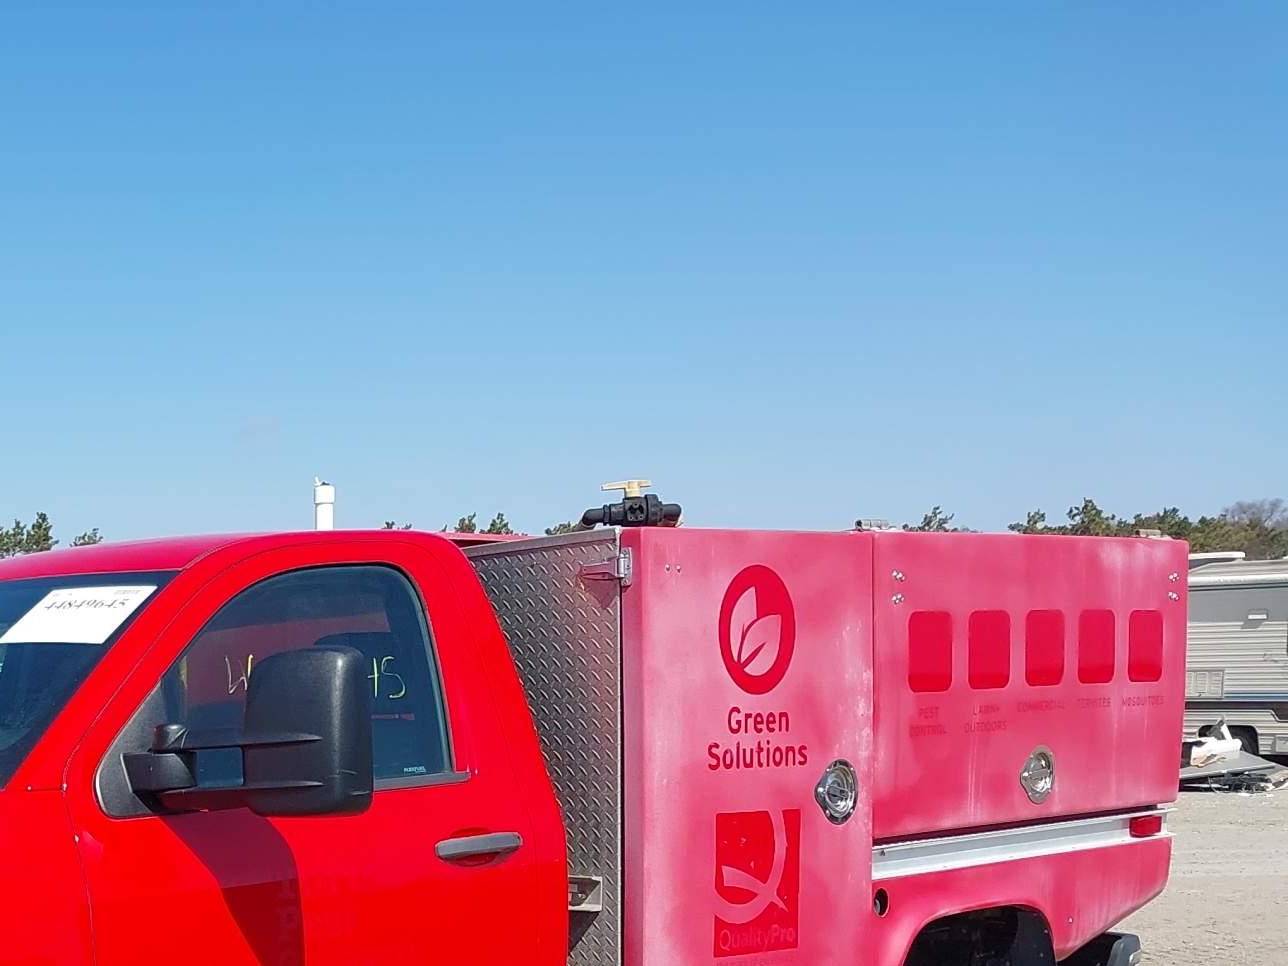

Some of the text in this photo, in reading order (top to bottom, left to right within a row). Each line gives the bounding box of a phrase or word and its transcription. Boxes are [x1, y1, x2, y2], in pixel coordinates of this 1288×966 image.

[728, 706, 789, 734] Green
[708, 739, 808, 770] Solutions
[719, 924, 795, 953] QualityPro
